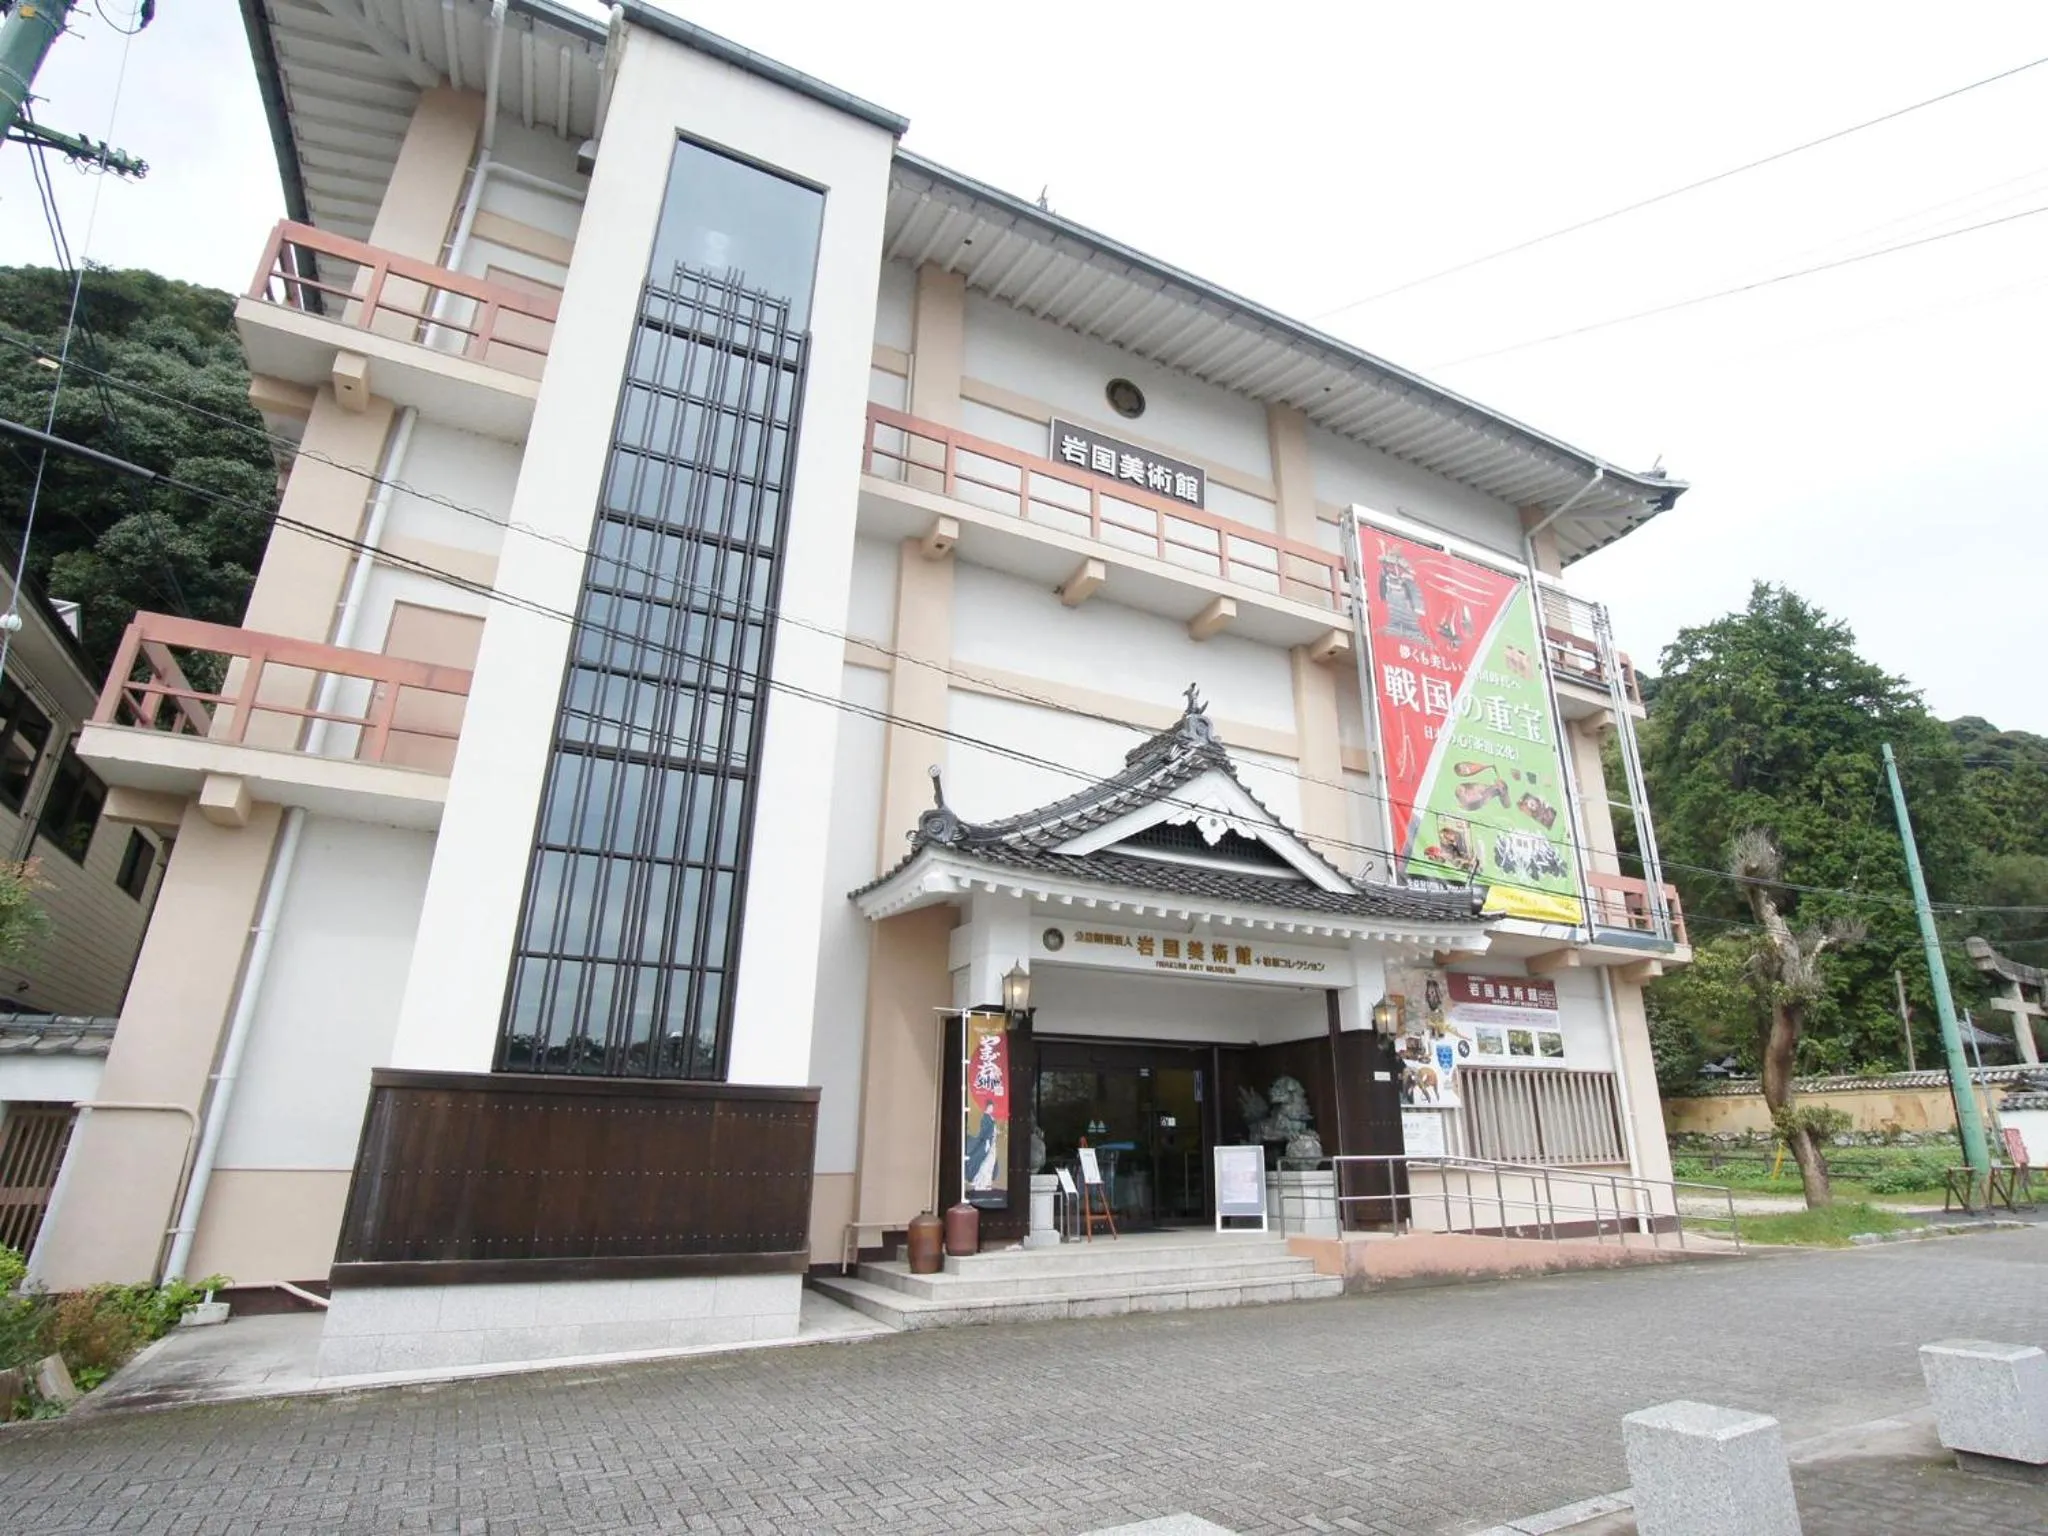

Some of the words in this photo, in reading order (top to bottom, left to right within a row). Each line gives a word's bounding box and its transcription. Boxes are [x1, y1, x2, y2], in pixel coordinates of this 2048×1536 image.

[1061, 434, 1199, 503] 岩国美術館
[1383, 664, 1548, 745] 戦国の重宝
[1137, 934, 1252, 966] 岩国美術館
